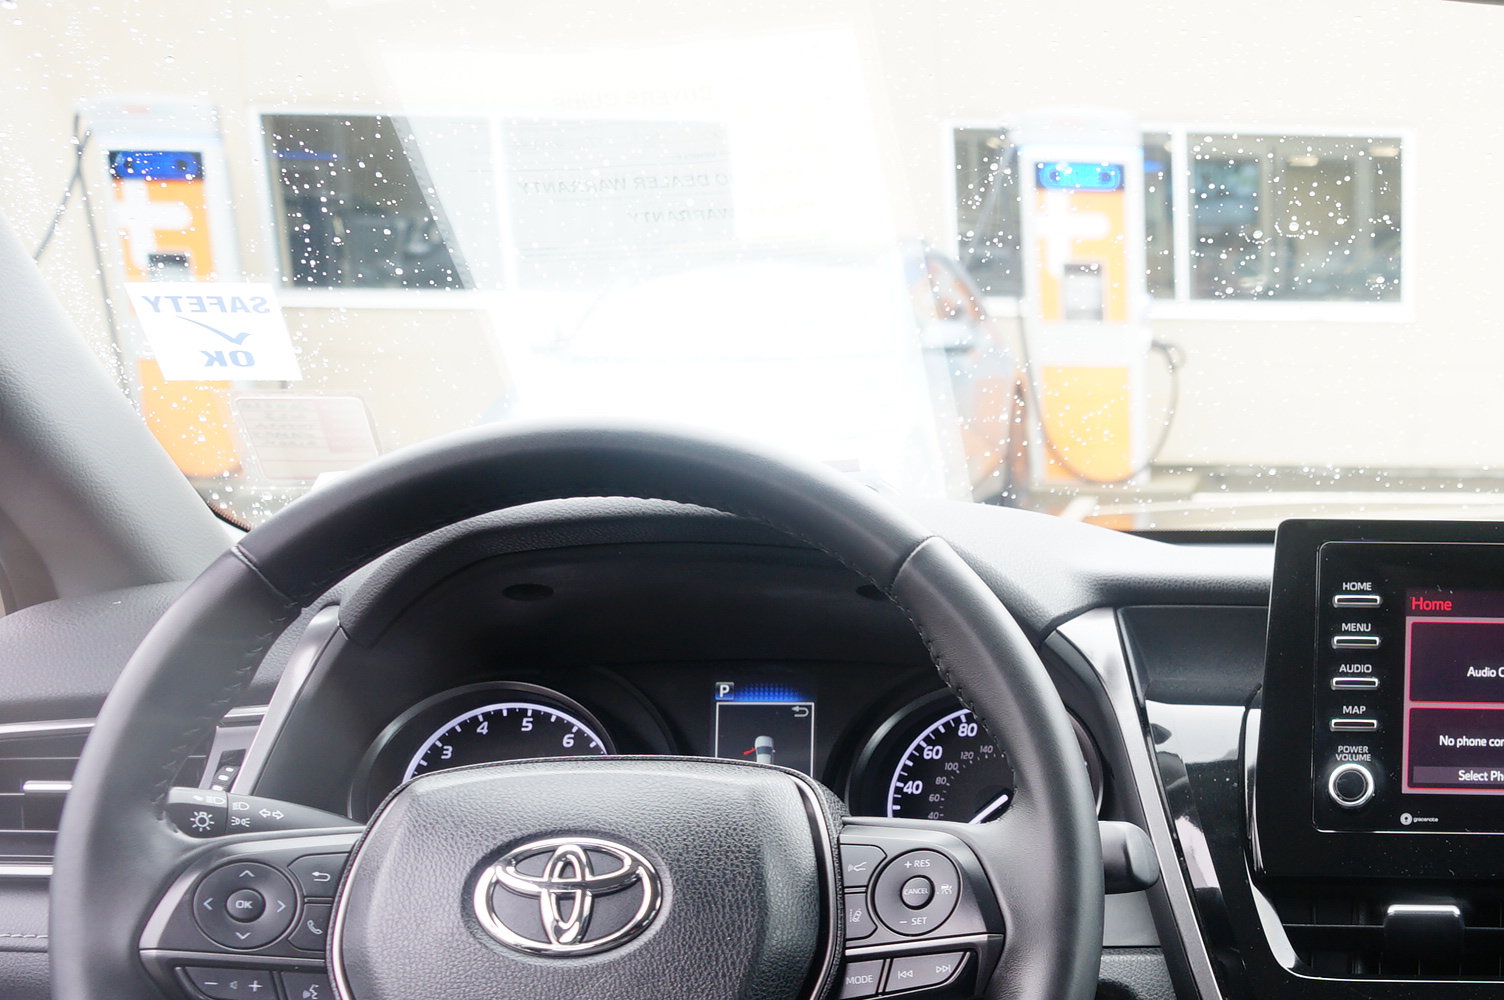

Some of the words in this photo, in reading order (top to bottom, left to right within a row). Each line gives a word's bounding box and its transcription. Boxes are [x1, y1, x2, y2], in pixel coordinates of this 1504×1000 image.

[1342, 582, 1372, 591] HOME
[1411, 597, 1453, 611] Home
[1341, 623, 1372, 632] MENU
[1339, 664, 1373, 673] AUDIO
[1467, 667, 1497, 678] Audio
[719, 684, 730, 698] P
[1342, 706, 1367, 715] MAP
[476, 721, 489, 735] 4
[521, 718, 534, 732] 5
[957, 723, 978, 737] 80
[562, 734, 575, 748] 6
[1439, 735, 1454, 746] No
[1457, 736, 1487, 748] phone
[441, 745, 453, 759] 3
[922, 746, 943, 760] 60
[980, 745, 994, 754] 140
[1338, 745, 1369, 753] POWER
[960, 751, 975, 760] 120
[1335, 753, 1372, 762] VOLUME
[944, 762, 959, 771] 100
[935, 776, 947, 785] 80
[1458, 770, 1488, 781] Select
[903, 780, 923, 795] 40
[928, 793, 941, 804] 60
[914, 858, 931, 868] RES
[903, 887, 929, 896] CANCEL
[234, 899, 254, 910] OK
[911, 917, 928, 926] SET
[845, 973, 874, 985] MODE
